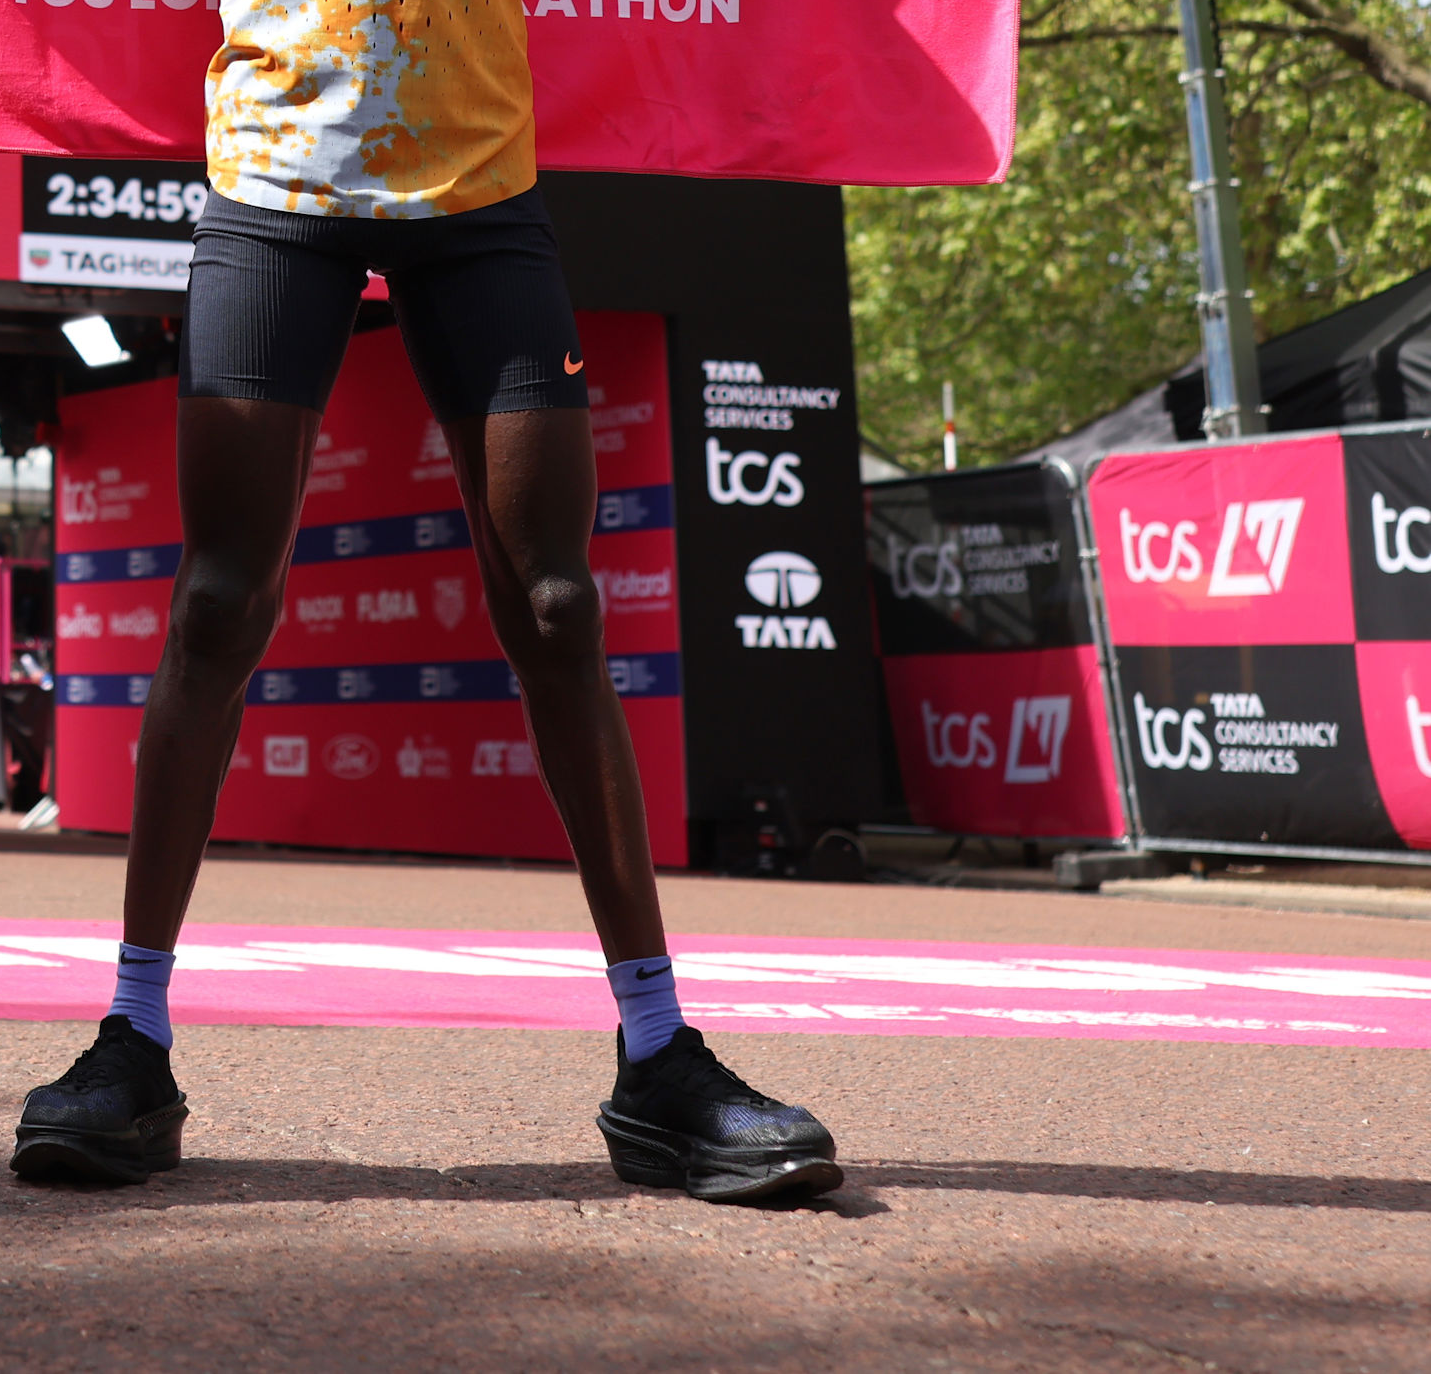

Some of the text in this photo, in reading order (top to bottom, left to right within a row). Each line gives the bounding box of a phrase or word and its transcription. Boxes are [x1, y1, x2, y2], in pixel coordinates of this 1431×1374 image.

[47, 173, 206, 225] 2:34:59
[701, 360, 764, 383] TATA
[703, 383, 841, 409] CONSULTANCY
[704, 406, 794, 430] SERVICES
[706, 436, 804, 507] tcs
[1119, 508, 1203, 582] tcs
[1371, 491, 1431, 574] tc
[888, 532, 962, 598] tcs
[736, 616, 836, 650] TATA
[923, 699, 996, 768] tcs
[1134, 691, 1265, 771] tcs TATA
[1214, 720, 1338, 747] CONSULTANCY
[1219, 749, 1299, 774] SERVICES
